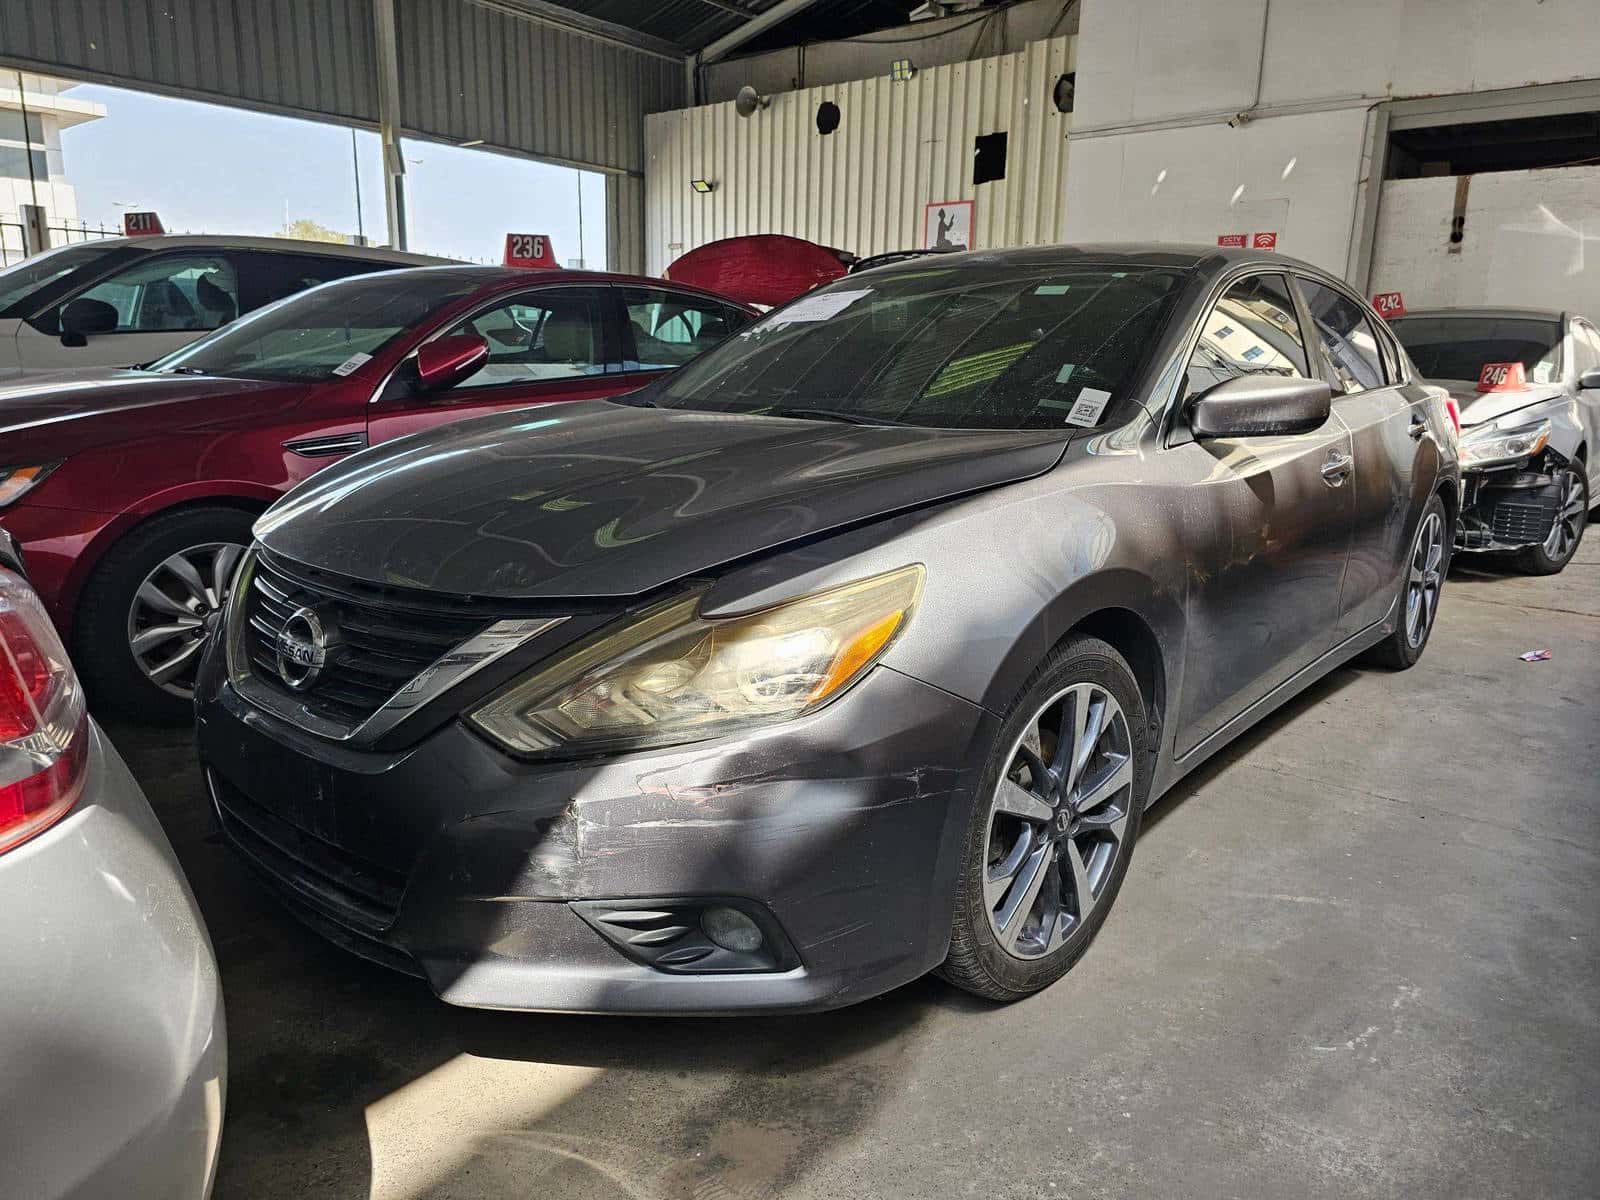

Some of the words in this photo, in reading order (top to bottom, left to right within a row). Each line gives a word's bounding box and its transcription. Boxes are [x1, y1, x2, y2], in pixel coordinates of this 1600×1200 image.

[130, 214, 151, 230] 211
[512, 236, 544, 259] 236
[1380, 294, 1401, 311] 242
[1483, 366, 1508, 385] 246
